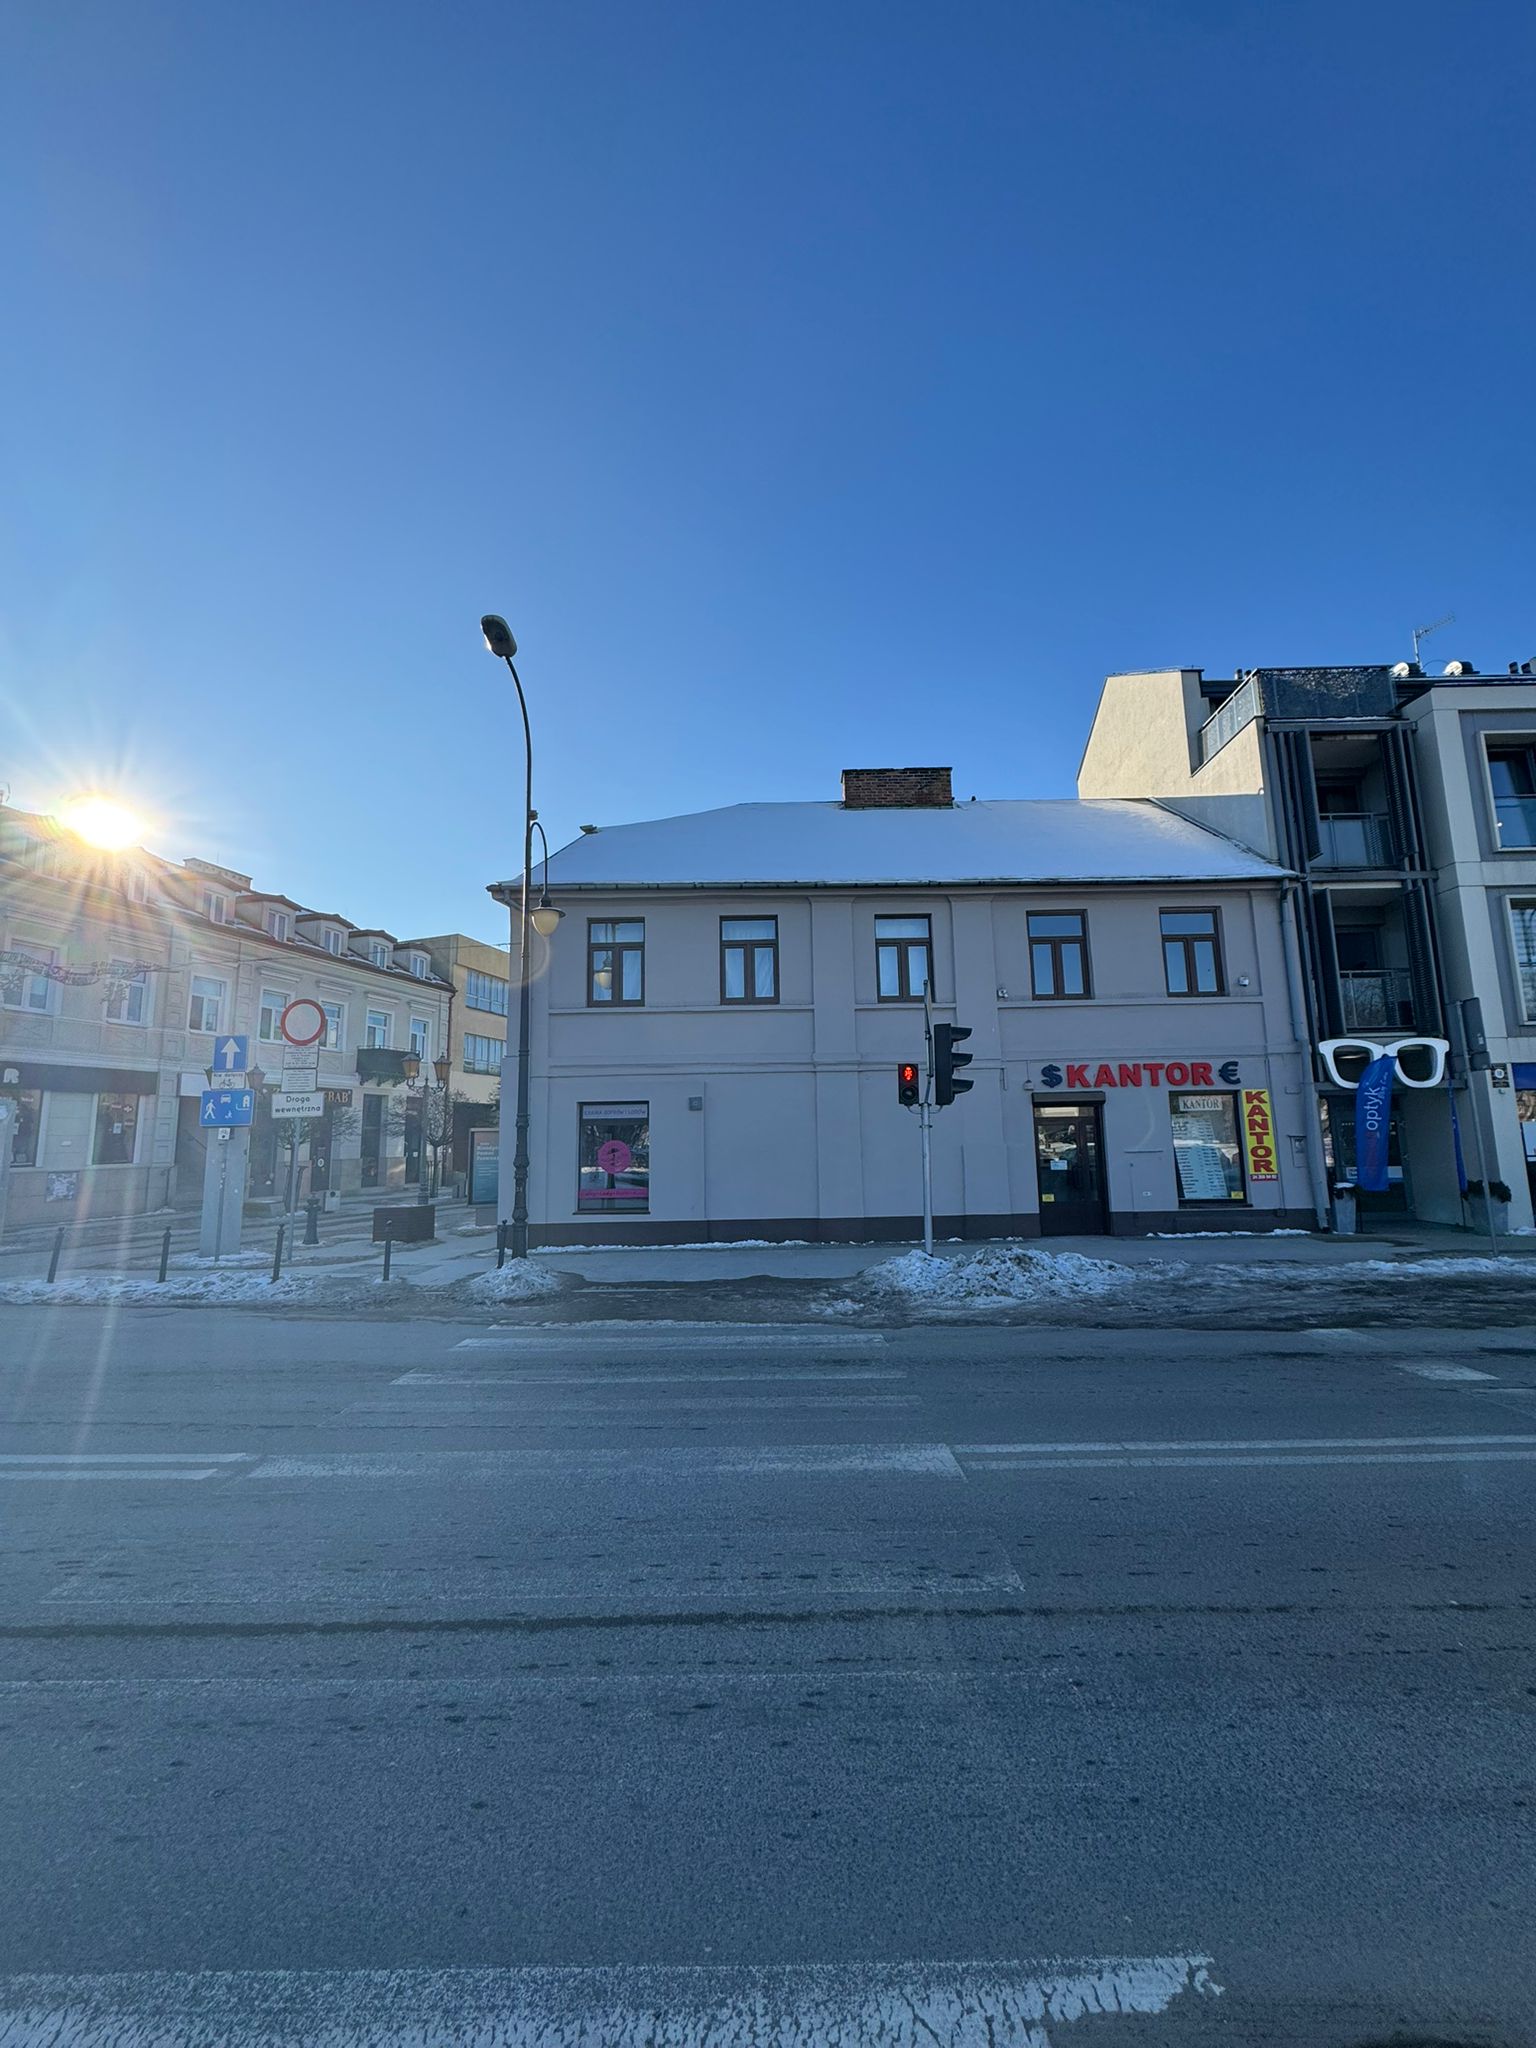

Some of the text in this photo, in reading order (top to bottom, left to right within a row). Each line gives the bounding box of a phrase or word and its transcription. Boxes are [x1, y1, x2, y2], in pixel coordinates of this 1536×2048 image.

[286, 1096, 310, 1105] Droga
[1183, 1099, 1219, 1110] KANTOR
[1364, 1086, 1382, 1130] optyk
[1245, 1091, 1275, 1173] KANTOR
